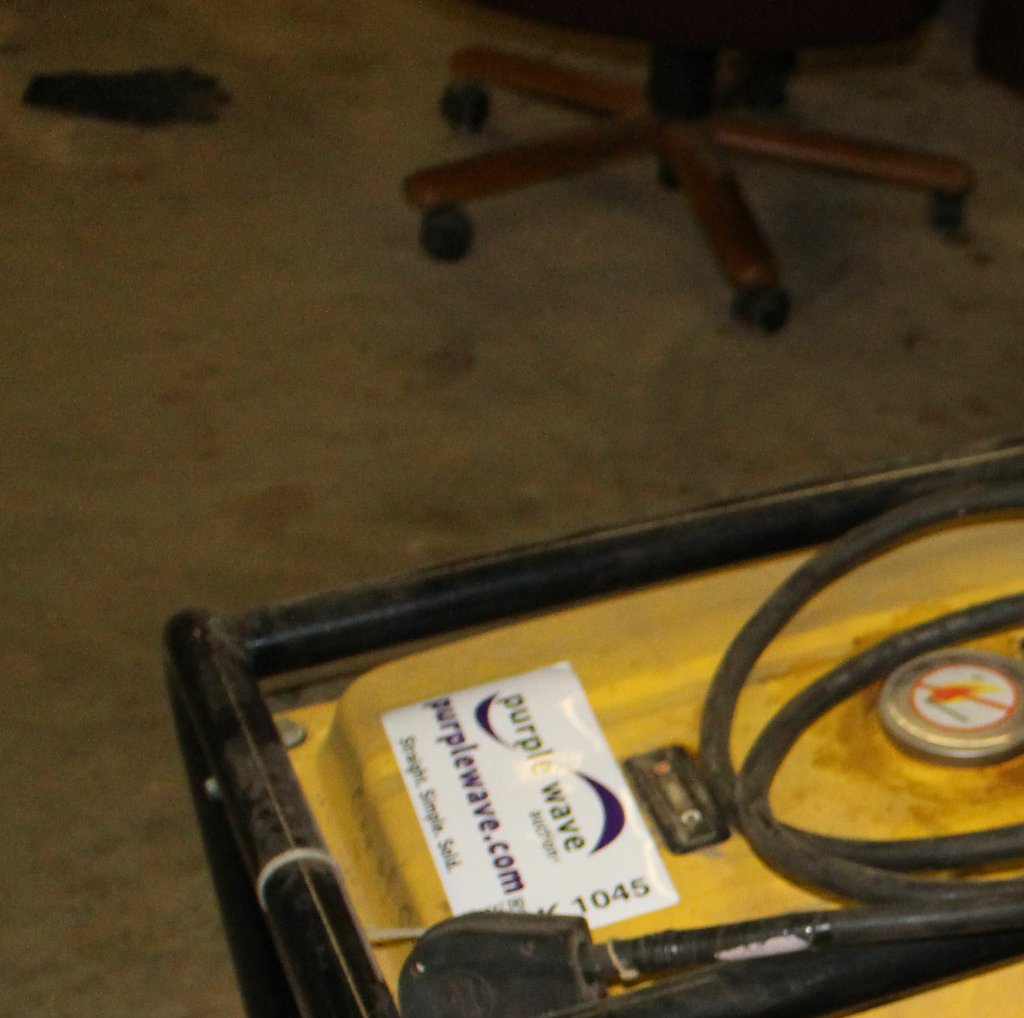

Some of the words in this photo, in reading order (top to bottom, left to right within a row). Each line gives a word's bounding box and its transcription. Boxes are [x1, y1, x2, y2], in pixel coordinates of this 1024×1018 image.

[424, 697, 525, 895] purplewave.com
[502, 693, 555, 776] purple
[541, 780, 587, 852] wave
[573, 878, 649, 914] 1045
